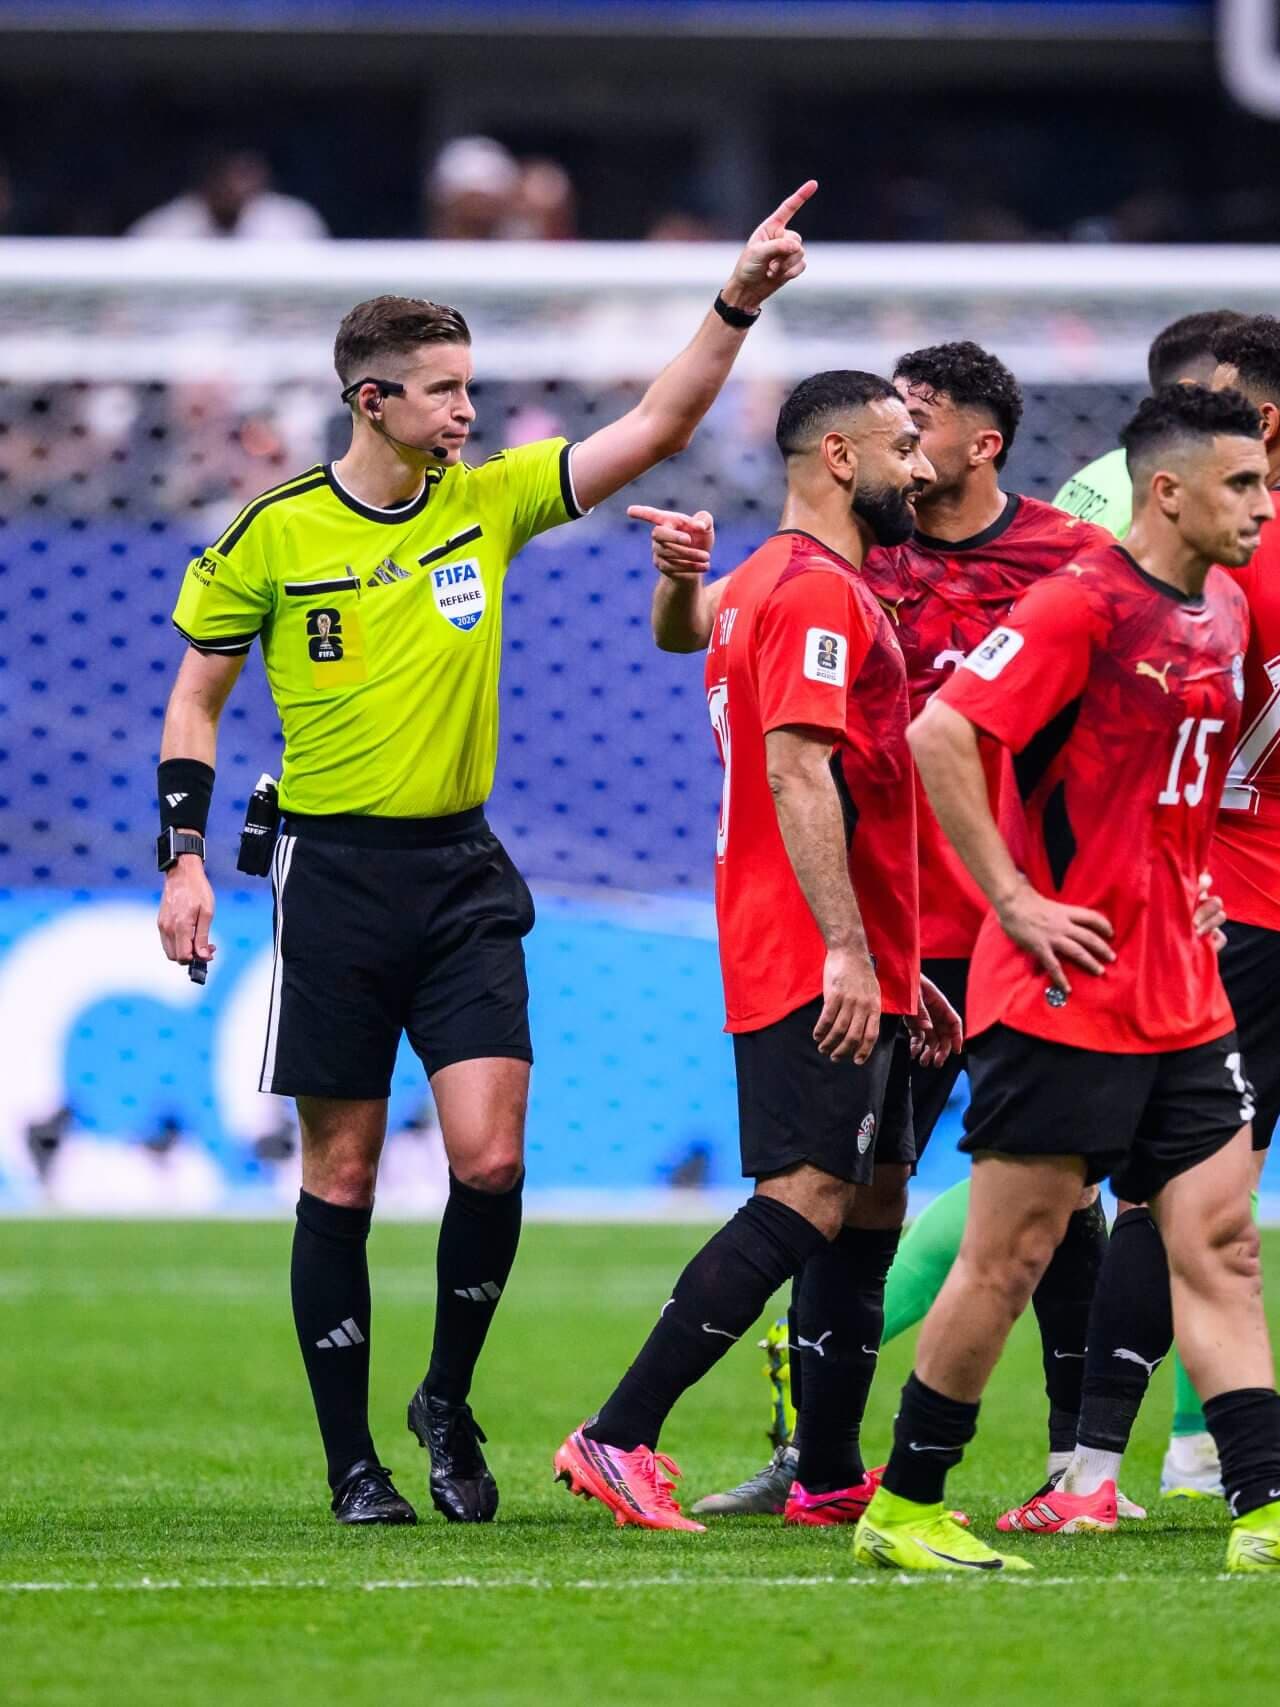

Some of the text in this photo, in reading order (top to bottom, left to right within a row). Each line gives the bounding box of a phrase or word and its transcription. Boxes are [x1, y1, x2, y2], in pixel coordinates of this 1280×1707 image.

[434, 564, 477, 588] FIFA
[439, 590, 483, 608] REFEREE
[457, 615, 477, 626] 2026
[318, 650, 335, 658] FIFA
[1158, 717, 1224, 807] 15
